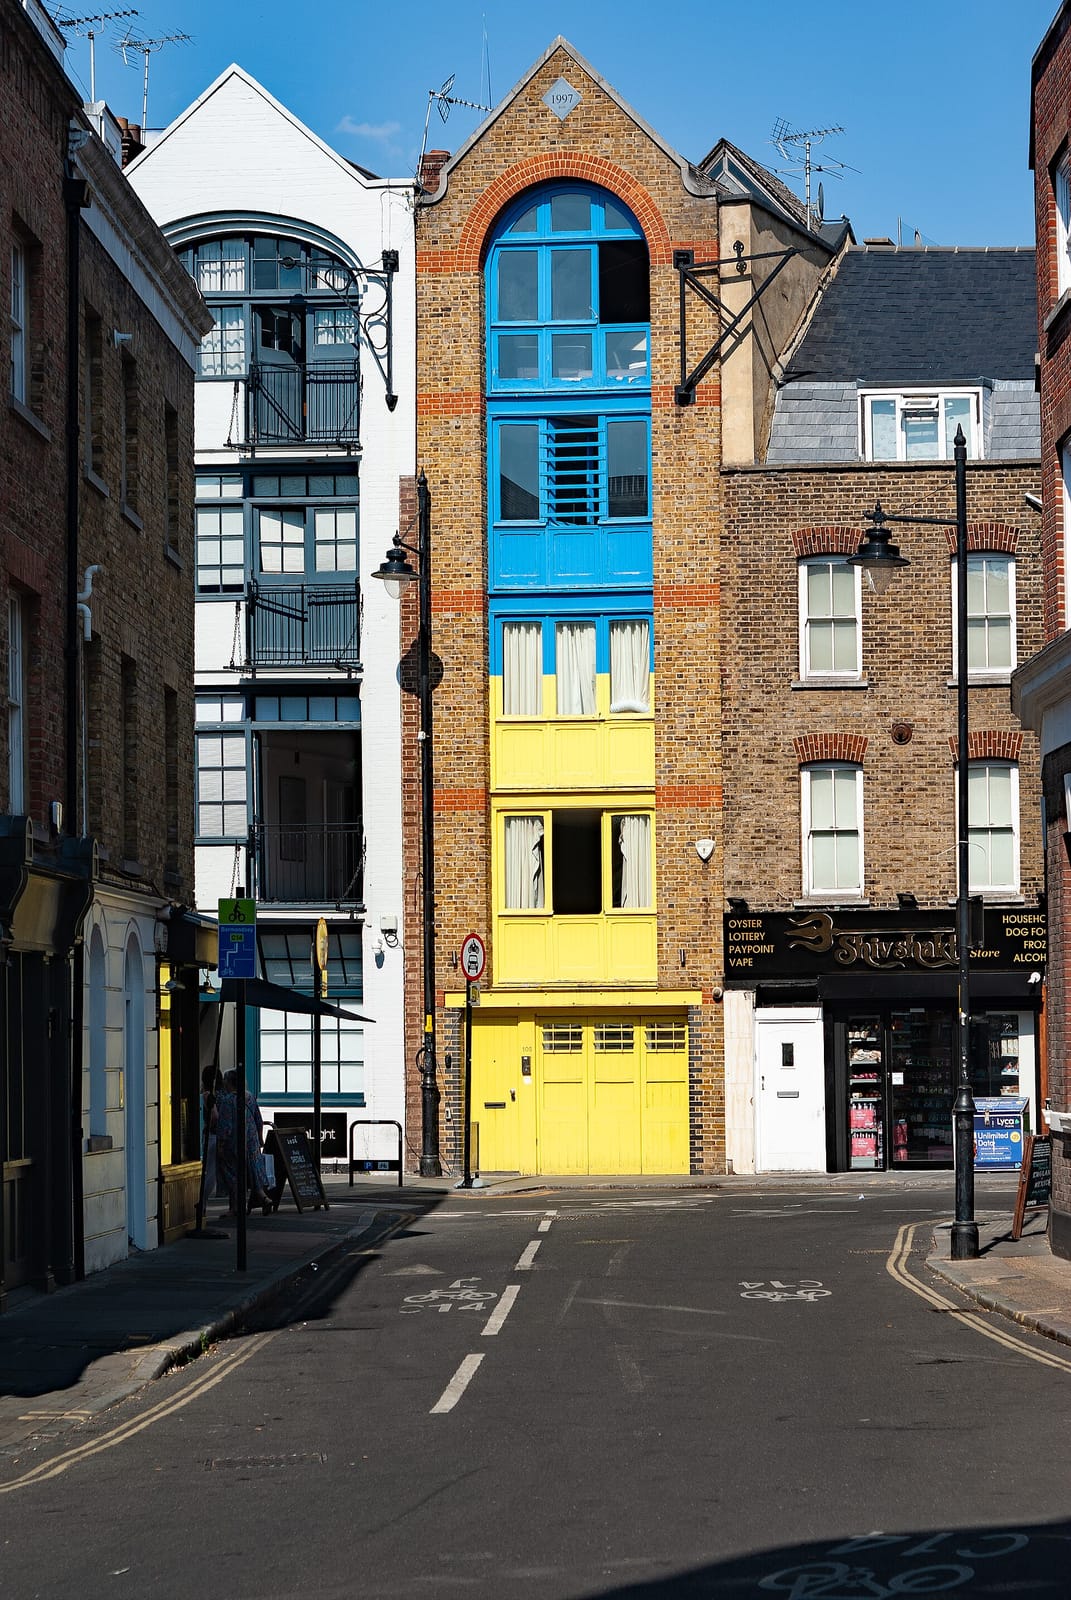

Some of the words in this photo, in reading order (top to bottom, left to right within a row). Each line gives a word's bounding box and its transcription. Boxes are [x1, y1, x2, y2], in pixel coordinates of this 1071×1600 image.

[552, 93, 574, 104] 1997
[728, 919, 762, 929] OYSTER
[728, 932, 765, 941] LOTTERY
[1005, 927, 1029, 937] DOG
[1031, 927, 1046, 936] FO
[728, 944, 775, 954] PAYPOINT
[1023, 940, 1047, 949] FROZ
[833, 933, 960, 968] Shivshakt
[969, 949, 1000, 958] Store
[728, 957, 753, 967] VAPE
[1013, 953, 1047, 962] ALCOH
[996, 1117, 1015, 1127] Lyca
[977, 1131, 1009, 1140] Unlimited
[399, 1302, 486, 1314] C14
[826, 1531, 1030, 1558] C14
